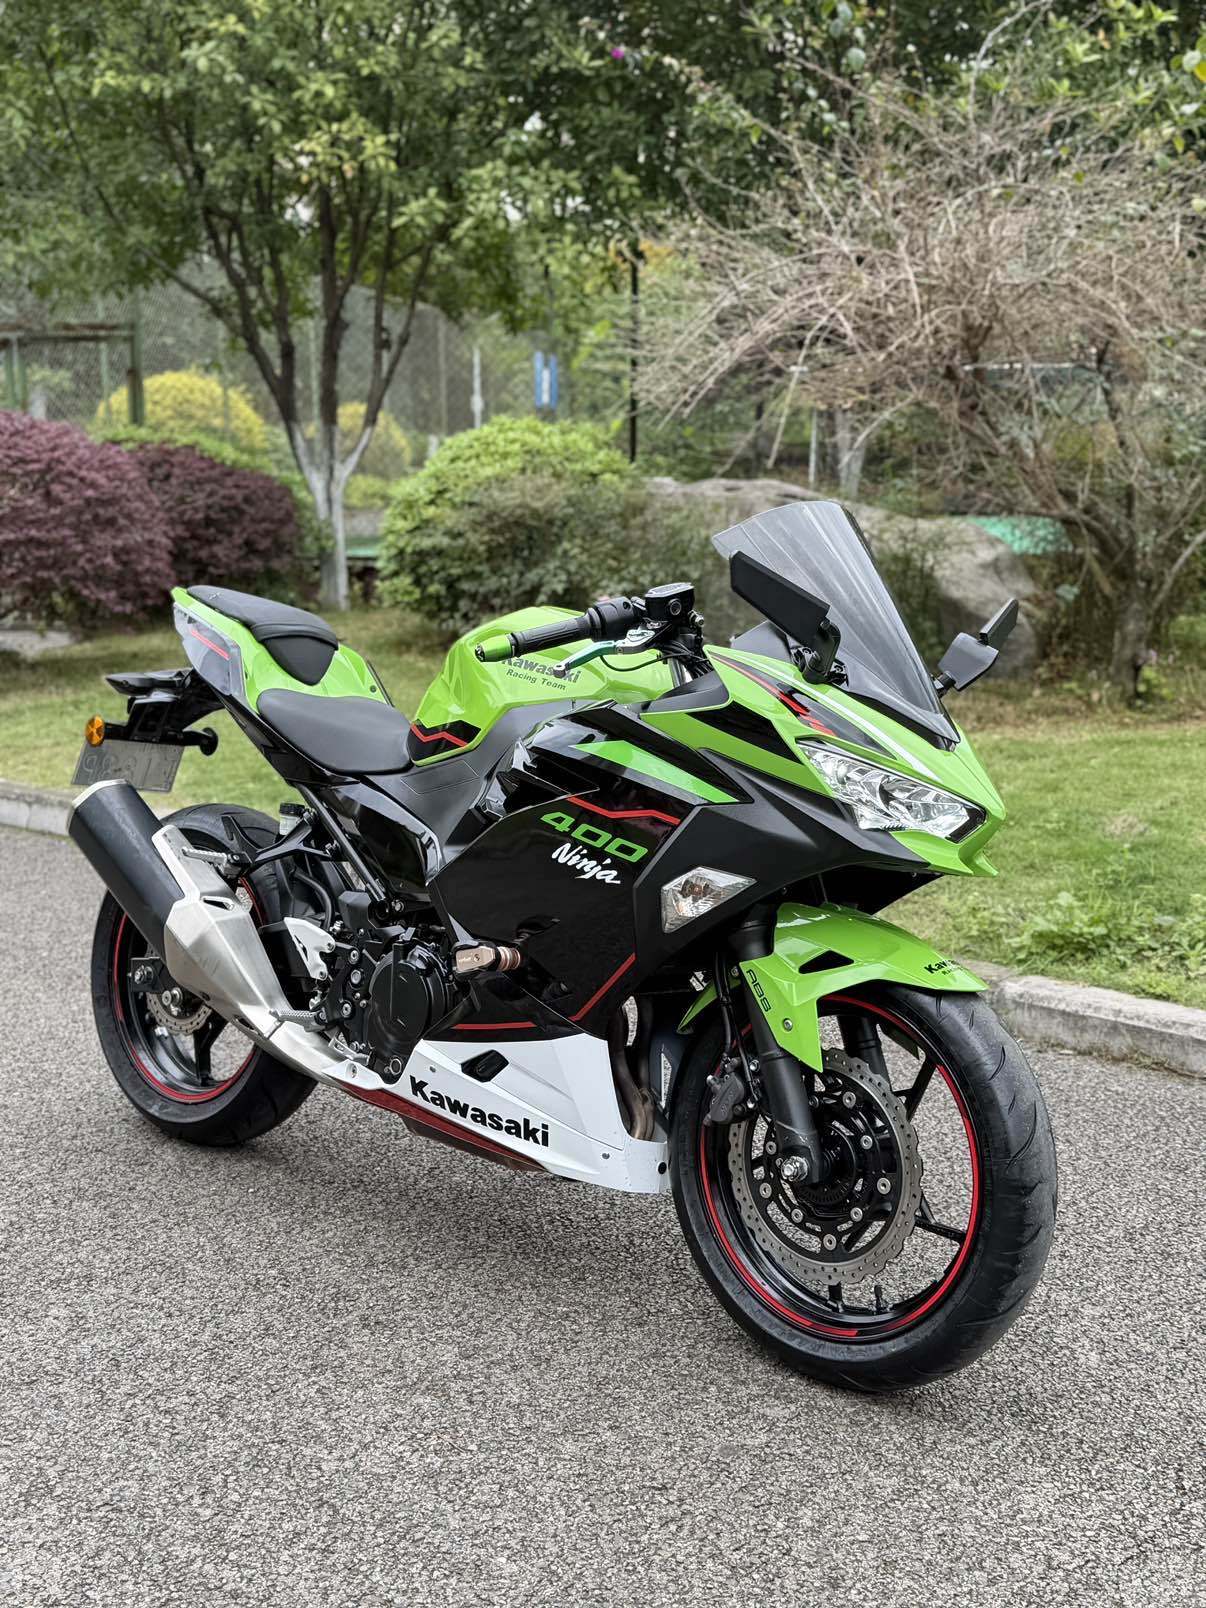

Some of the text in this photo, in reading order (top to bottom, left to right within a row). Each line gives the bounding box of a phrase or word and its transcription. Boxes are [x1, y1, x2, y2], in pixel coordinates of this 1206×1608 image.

[506, 668, 567, 691] Racing Team
[540, 811, 649, 863] 400
[551, 842, 621, 884] Ninja
[746, 969, 772, 1012] ABS
[409, 1074, 549, 1147] Kawasaki
